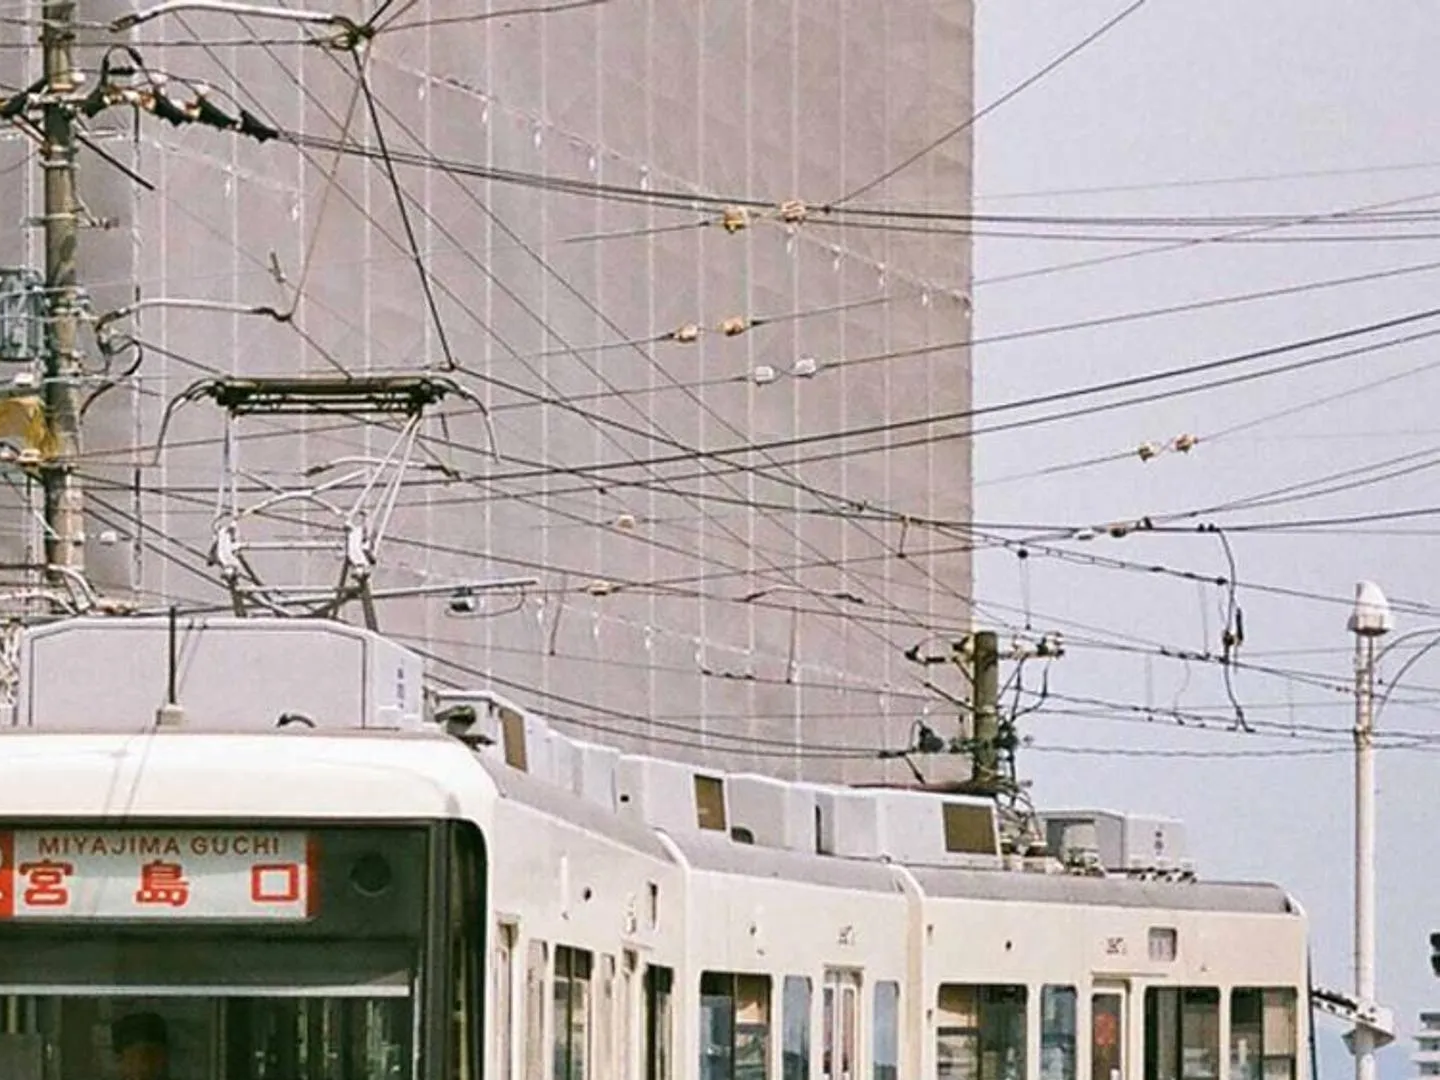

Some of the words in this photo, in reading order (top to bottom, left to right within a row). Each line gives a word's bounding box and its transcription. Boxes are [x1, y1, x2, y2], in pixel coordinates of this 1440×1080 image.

[38, 836, 181, 856] MIYAJIMA
[190, 836, 280, 856] GUCHI
[18, 859, 300, 906] 宮島口
